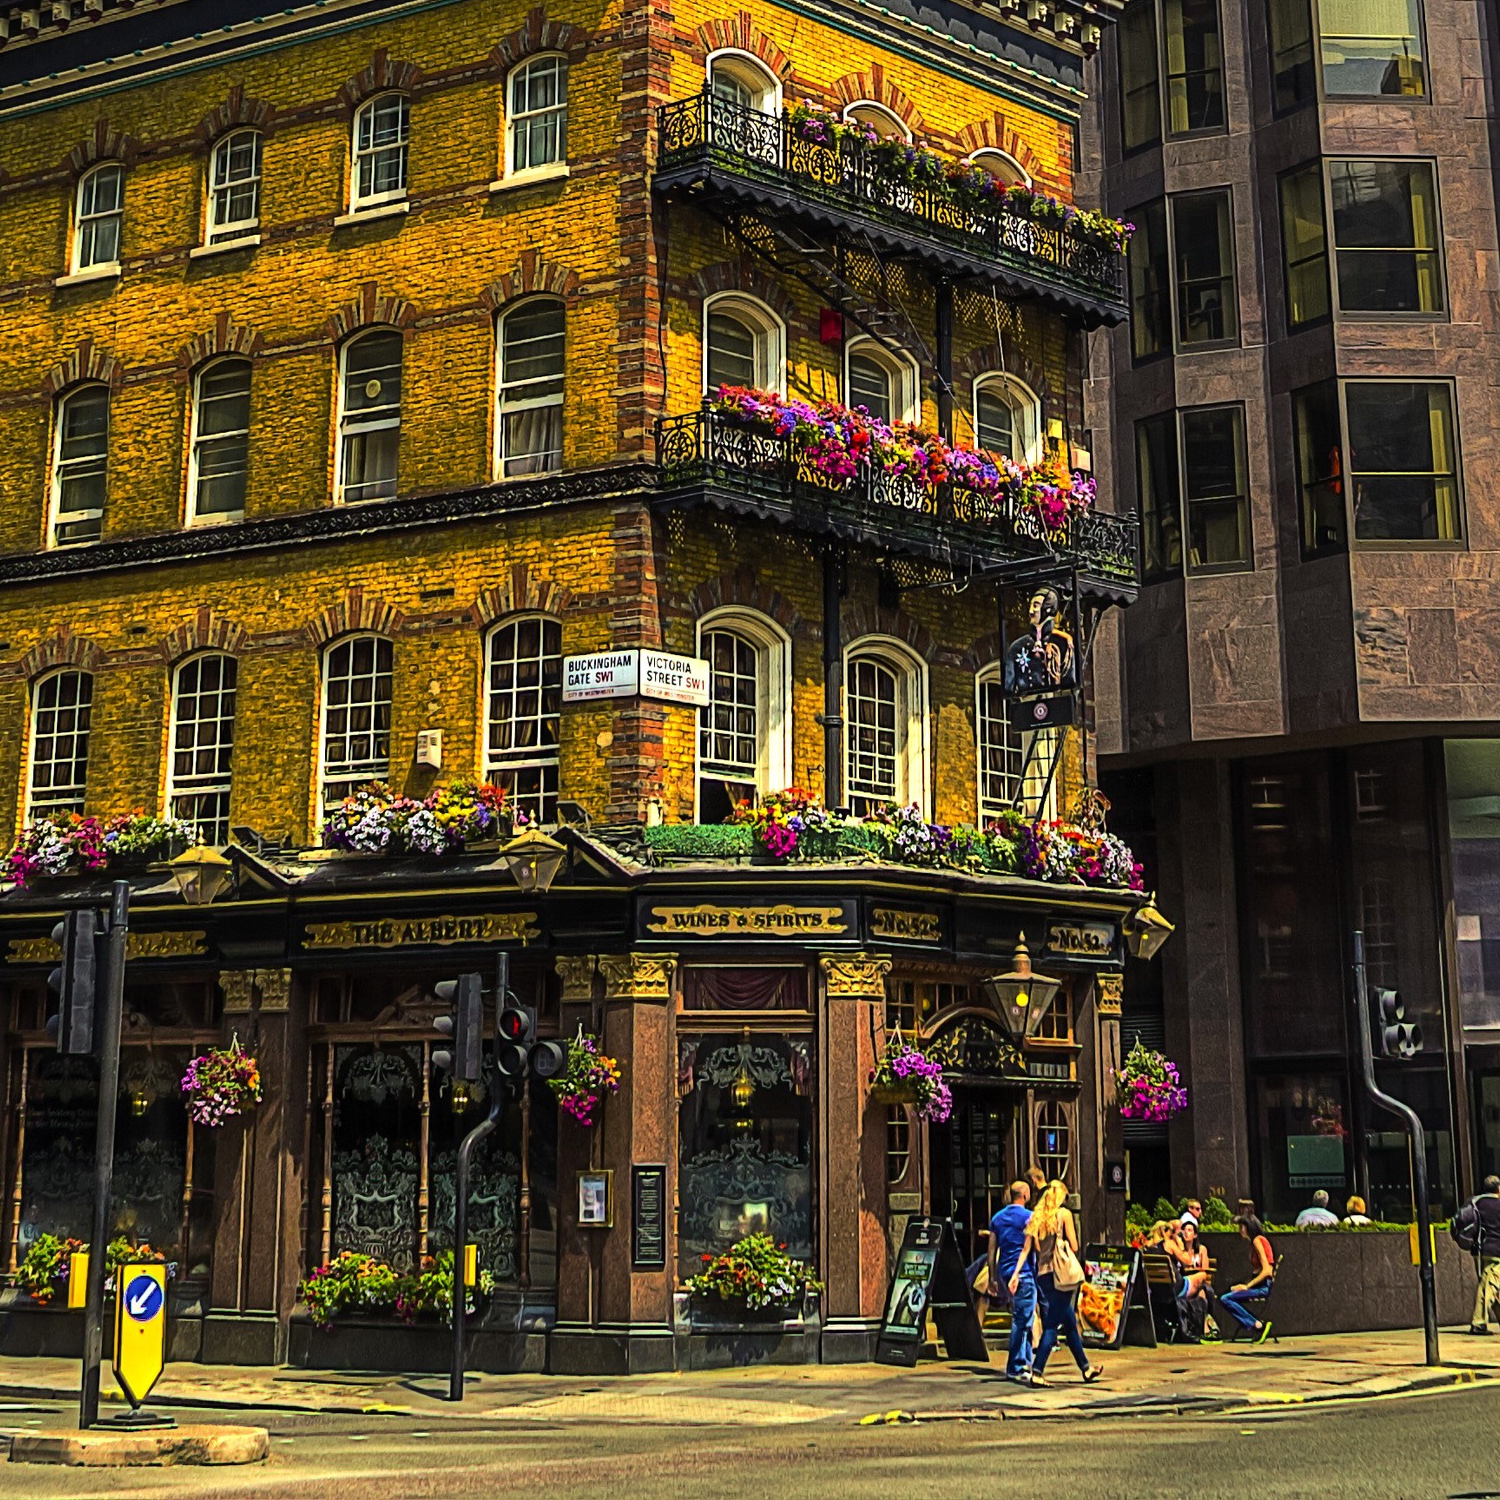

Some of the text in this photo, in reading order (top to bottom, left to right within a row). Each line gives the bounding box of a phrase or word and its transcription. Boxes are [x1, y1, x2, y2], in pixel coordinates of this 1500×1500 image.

[568, 655, 632, 672] BUCKINGHAM
[646, 656, 692, 674] VICTORIA
[568, 671, 614, 686] GATE SW1
[646, 670, 705, 690] STREET SW1
[672, 913, 730, 928] WINES
[755, 913, 823, 928] SPIRITS
[353, 919, 488, 945] THE ALBERT
